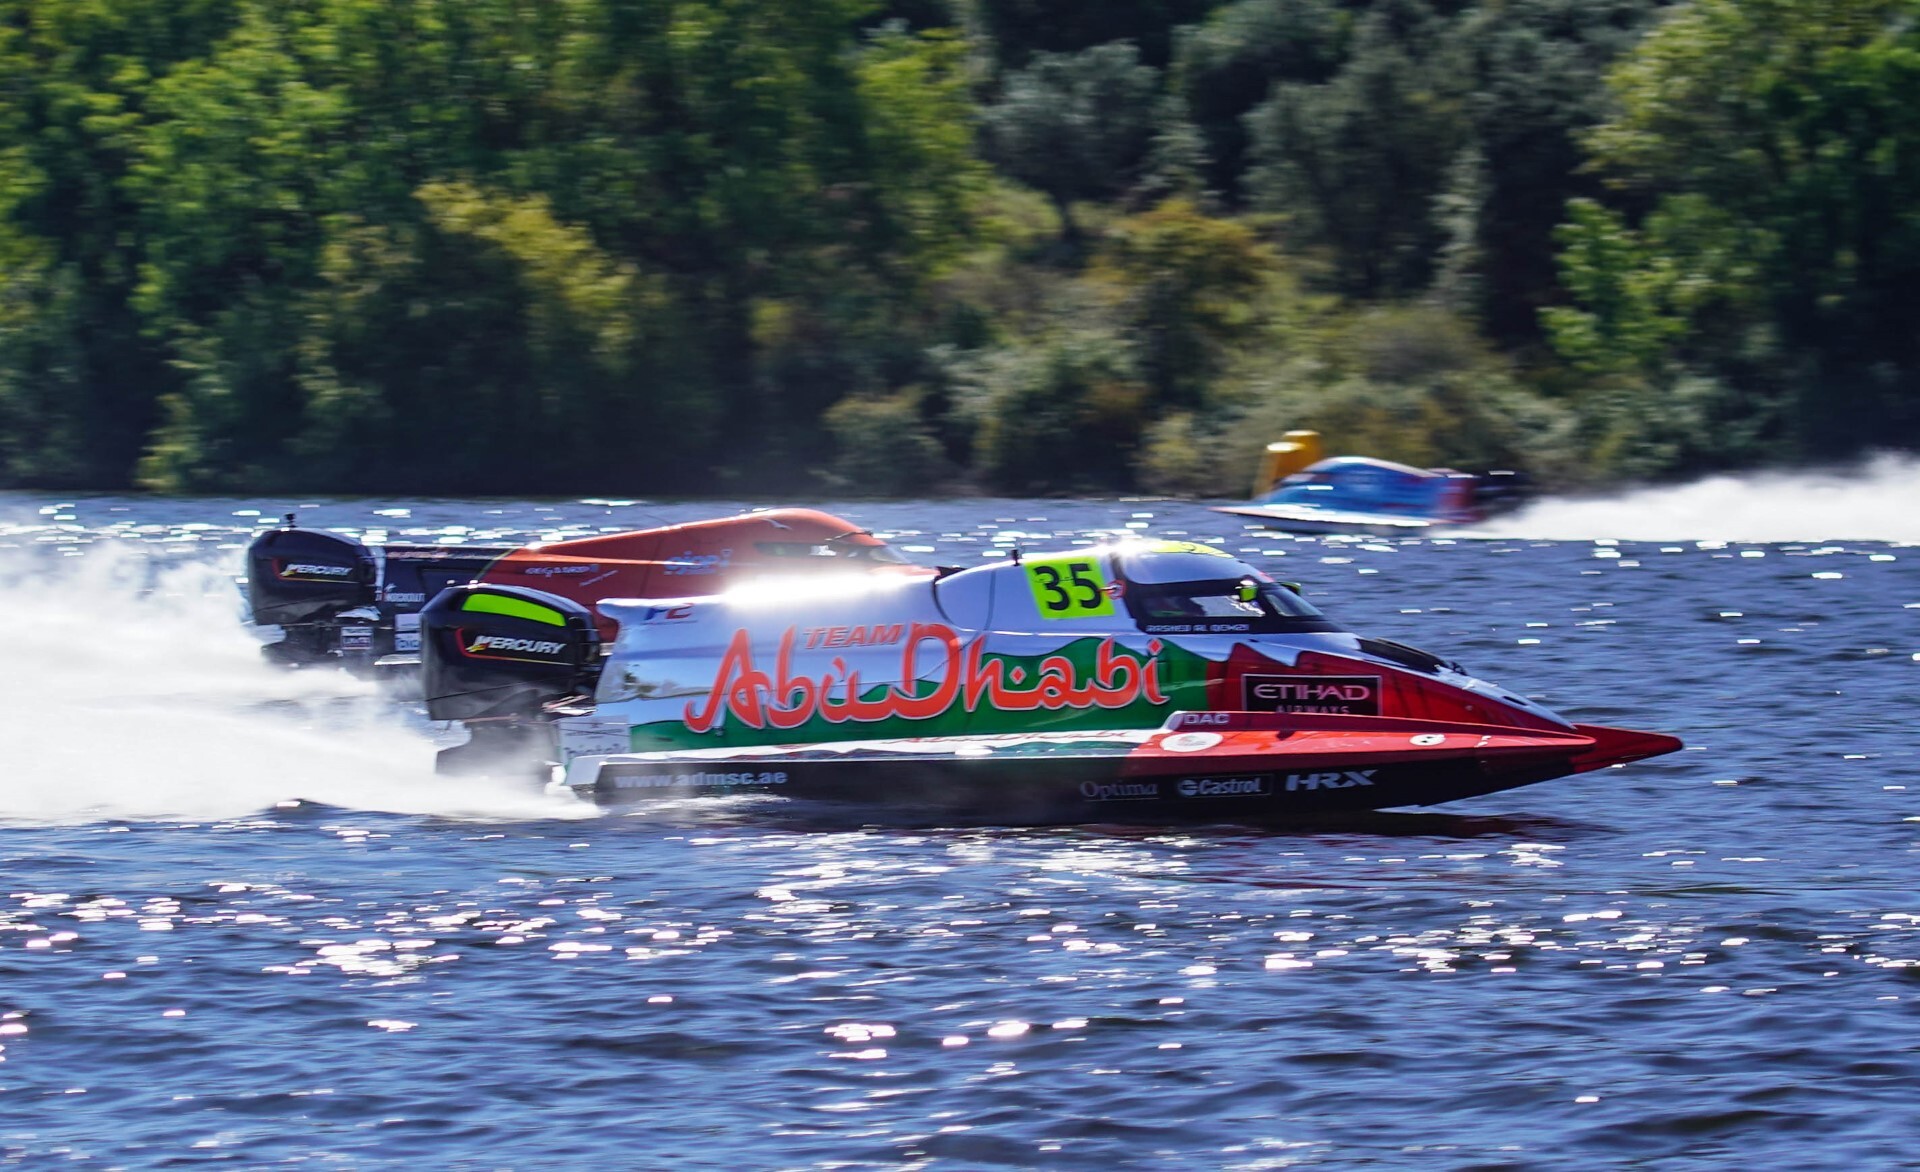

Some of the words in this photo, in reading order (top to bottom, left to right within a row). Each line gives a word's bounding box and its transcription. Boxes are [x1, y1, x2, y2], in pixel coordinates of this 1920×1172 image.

[282, 564, 353, 576] MERCURY
[1034, 563, 1102, 611] 35
[468, 636, 567, 655] MERCURY
[803, 624, 903, 649] TEAM
[1253, 683, 1370, 701] ETIHAD
[1183, 713, 1229, 725] DAC
[614, 772, 788, 788] www.admsc.ae
[1080, 780, 1157, 799] Optima
[1199, 776, 1260, 796] Castrol
[1286, 769, 1378, 792] HRX
